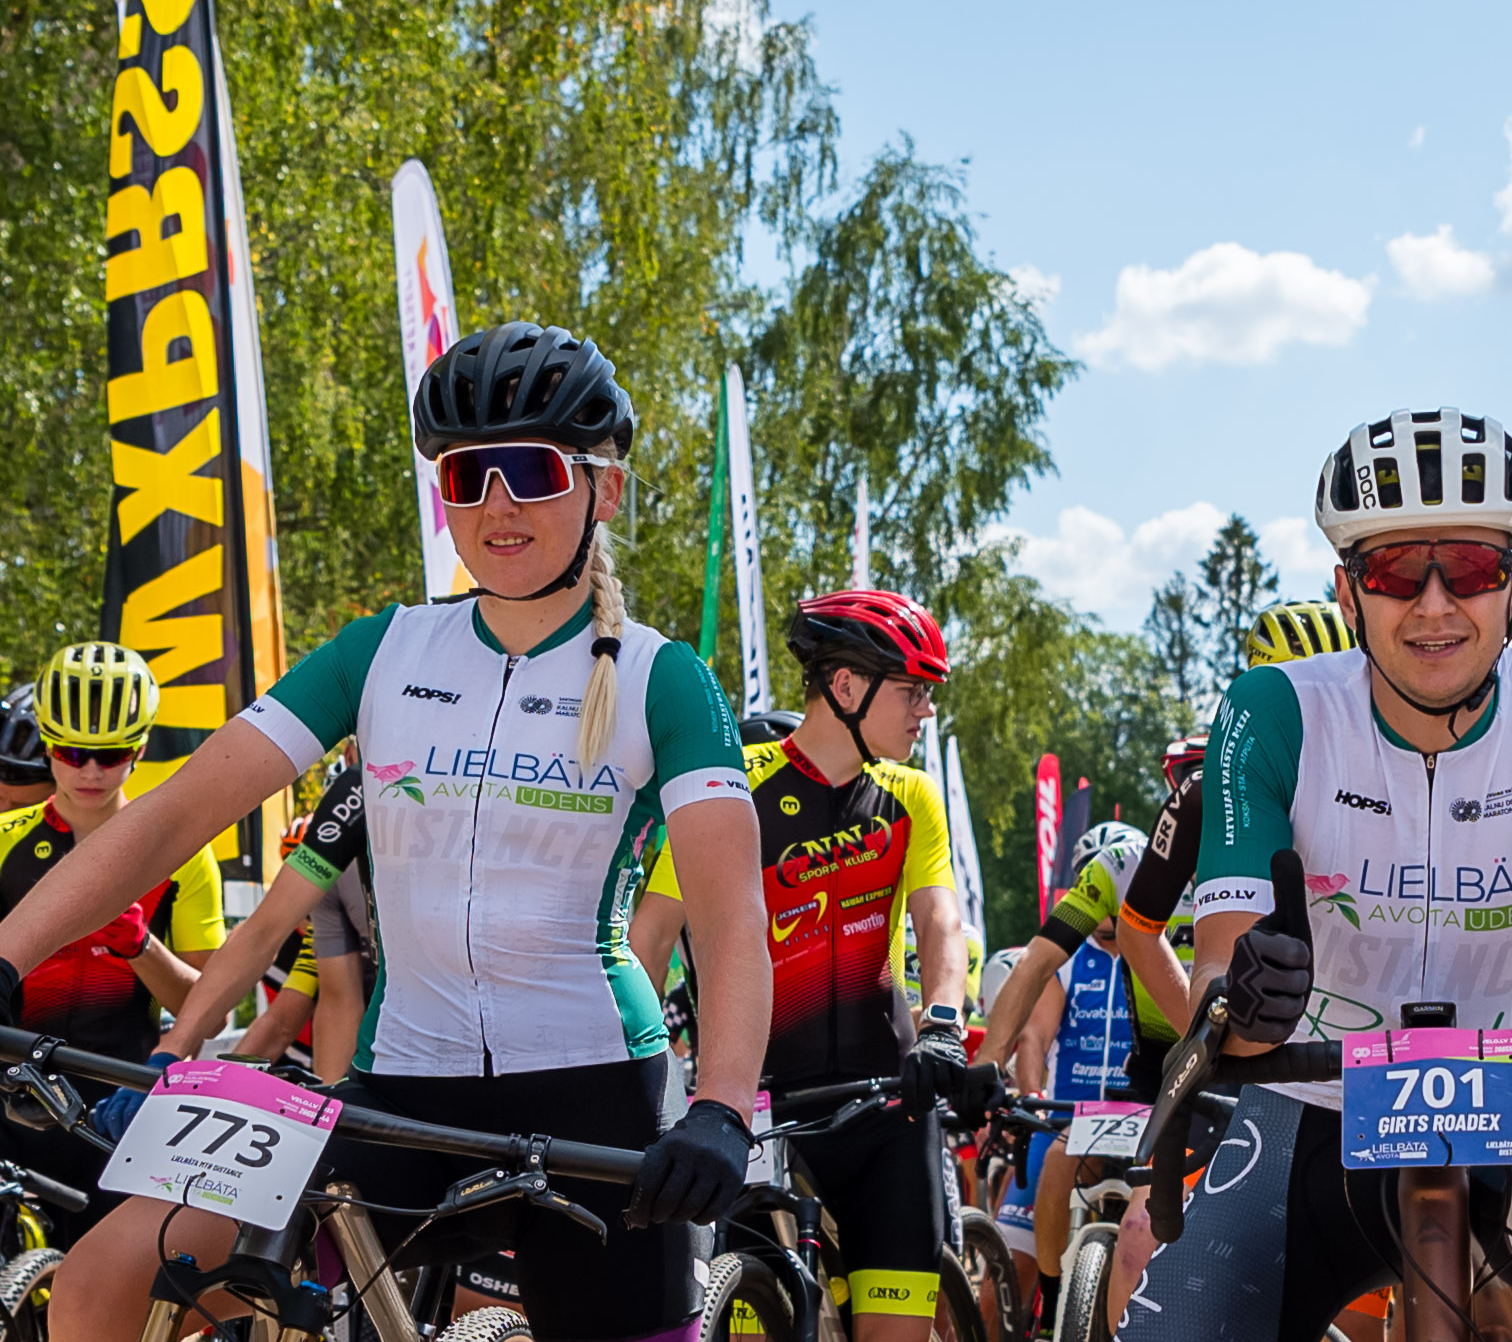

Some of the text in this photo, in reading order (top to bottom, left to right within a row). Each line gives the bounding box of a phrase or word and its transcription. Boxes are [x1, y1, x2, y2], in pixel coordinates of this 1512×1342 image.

[401, 684, 462, 705] HOPS!
[432, 781, 512, 801] AVOTA
[1334, 788, 1393, 817] HOPS!
[1154, 817, 1176, 853] SR
[796, 848, 878, 884] SPORTA KLUBS
[776, 899, 818, 921] JOKER
[1198, 890, 1257, 908] VELO.LV
[1368, 902, 1460, 930] AVOTA
[1168, 1053, 1198, 1098] GRX
[1385, 1067, 1485, 1112] 701
[164, 1104, 282, 1172] 773
[1090, 1117, 1139, 1139] 723
[1378, 1112, 1501, 1140] ĢIRTS ROADEX
[212, 1163, 244, 1179] DISTANCE
